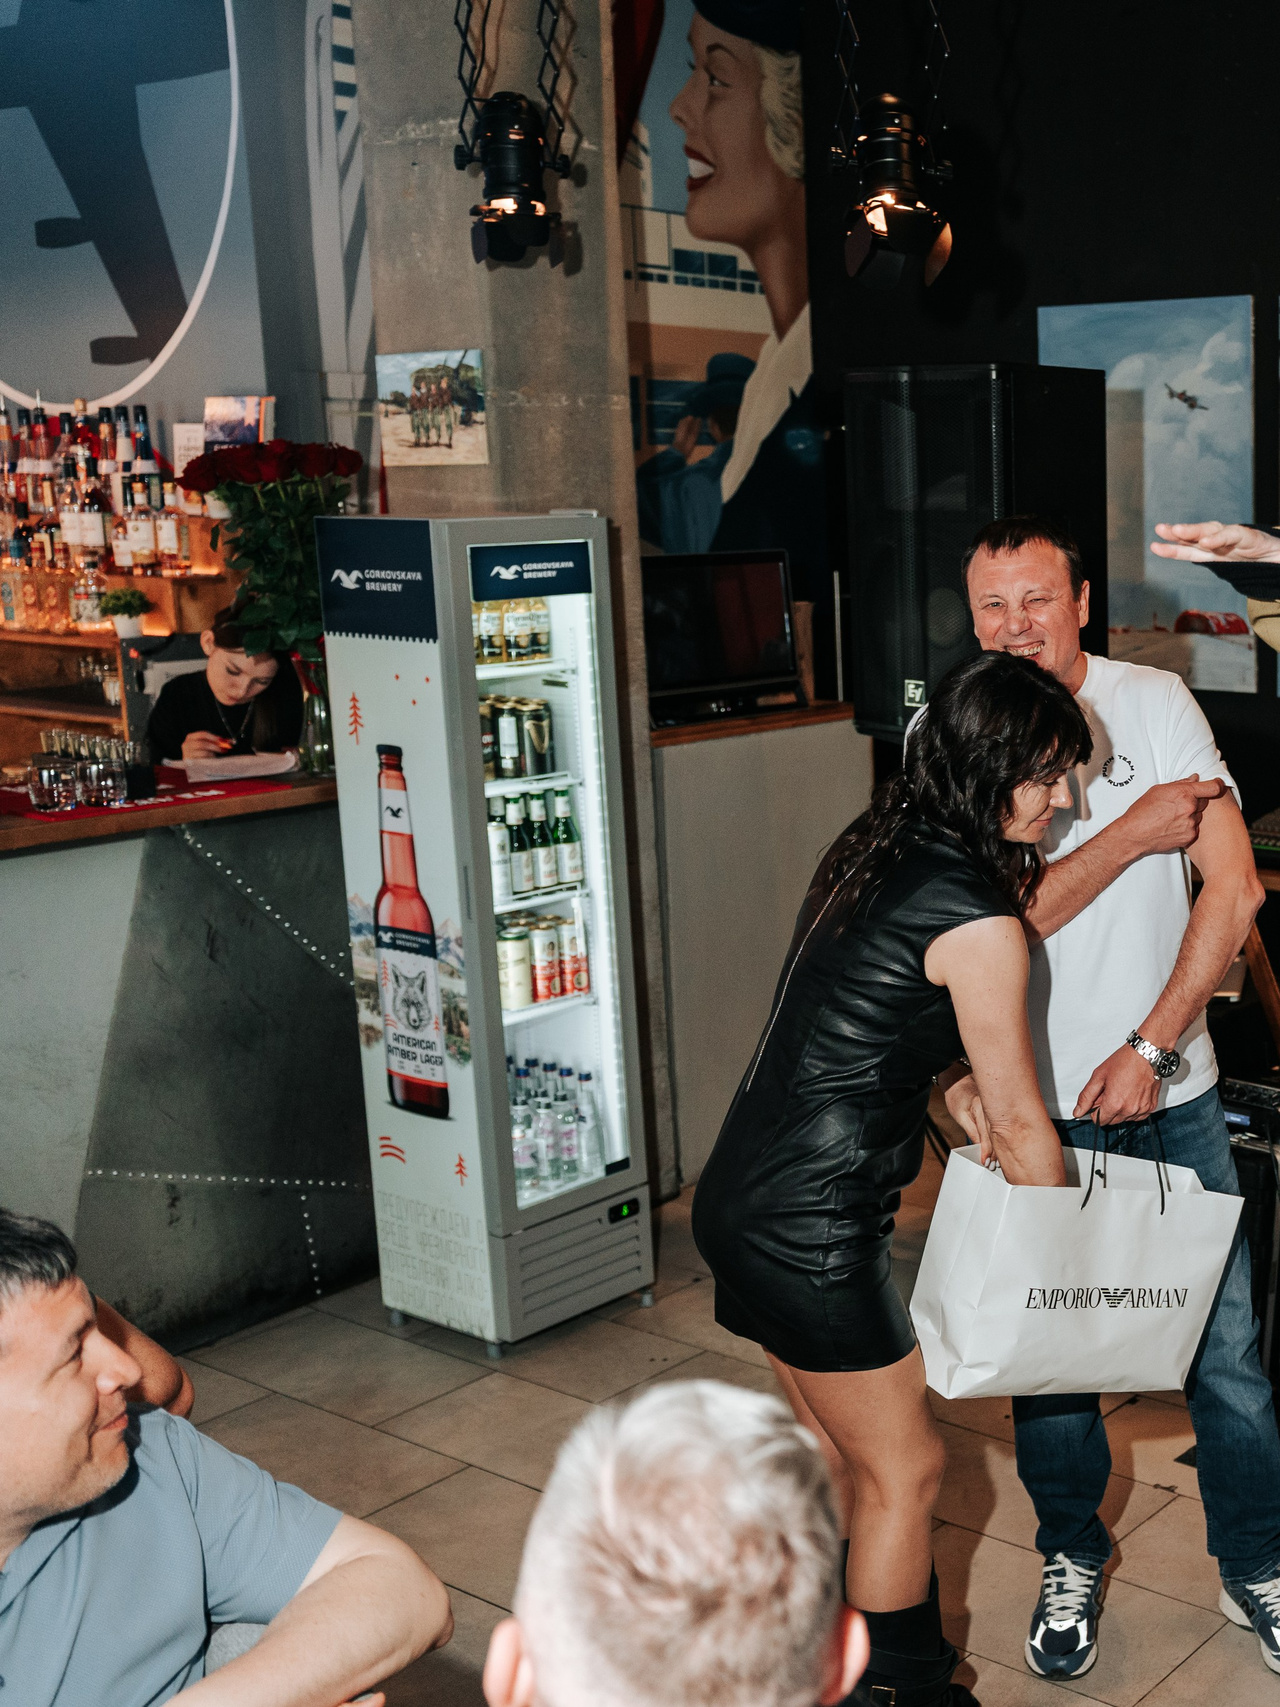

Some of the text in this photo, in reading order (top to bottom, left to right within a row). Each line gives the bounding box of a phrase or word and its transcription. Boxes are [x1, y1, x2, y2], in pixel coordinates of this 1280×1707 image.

[522, 561, 575, 571] GORKOVSKAYA
[364, 569, 423, 581] GORKOVSKAYA
[523, 570, 557, 579] BREWERY
[364, 581, 403, 592] BREWERY
[1102, 754, 1135, 777] PUTIN TEAM
[1107, 774, 1135, 787] RUSSIA
[392, 1032, 437, 1051] AMERICAN
[387, 1044, 443, 1066] AMBER LAGER
[1025, 1287, 1189, 1310] EMPORIO ARMANI
